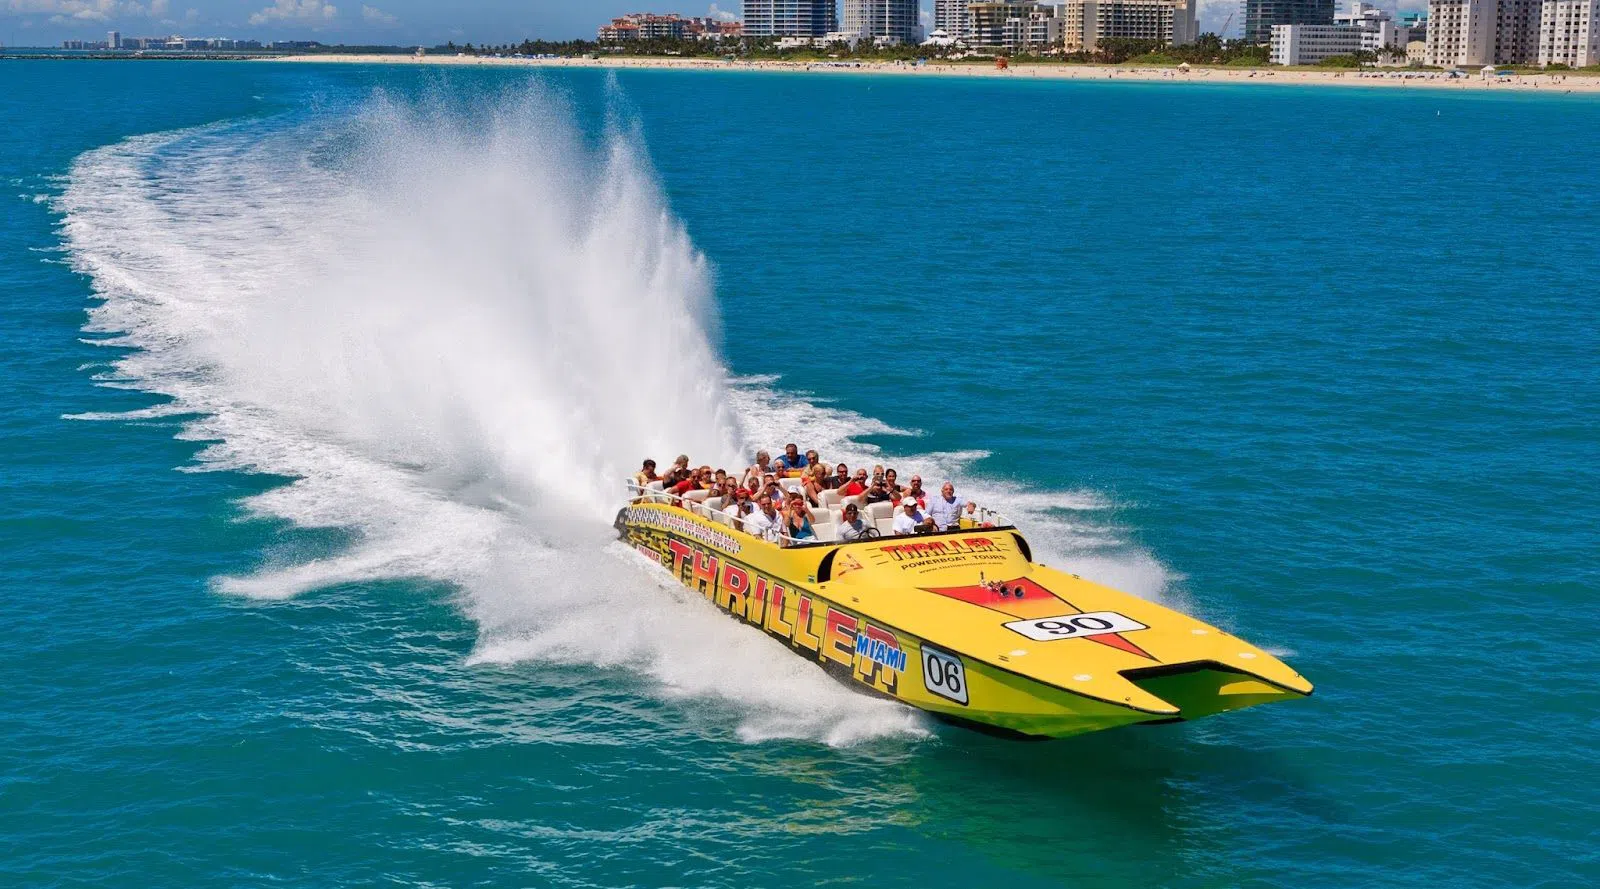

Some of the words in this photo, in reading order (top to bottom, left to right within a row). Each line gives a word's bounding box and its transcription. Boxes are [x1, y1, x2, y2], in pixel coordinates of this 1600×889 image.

[880, 537, 1001, 561] THRILLER
[901, 556, 967, 570] POWERBOAT
[668, 538, 900, 686] THRILLER
[855, 632, 907, 672] MIAMI
[927, 654, 961, 693] 06
